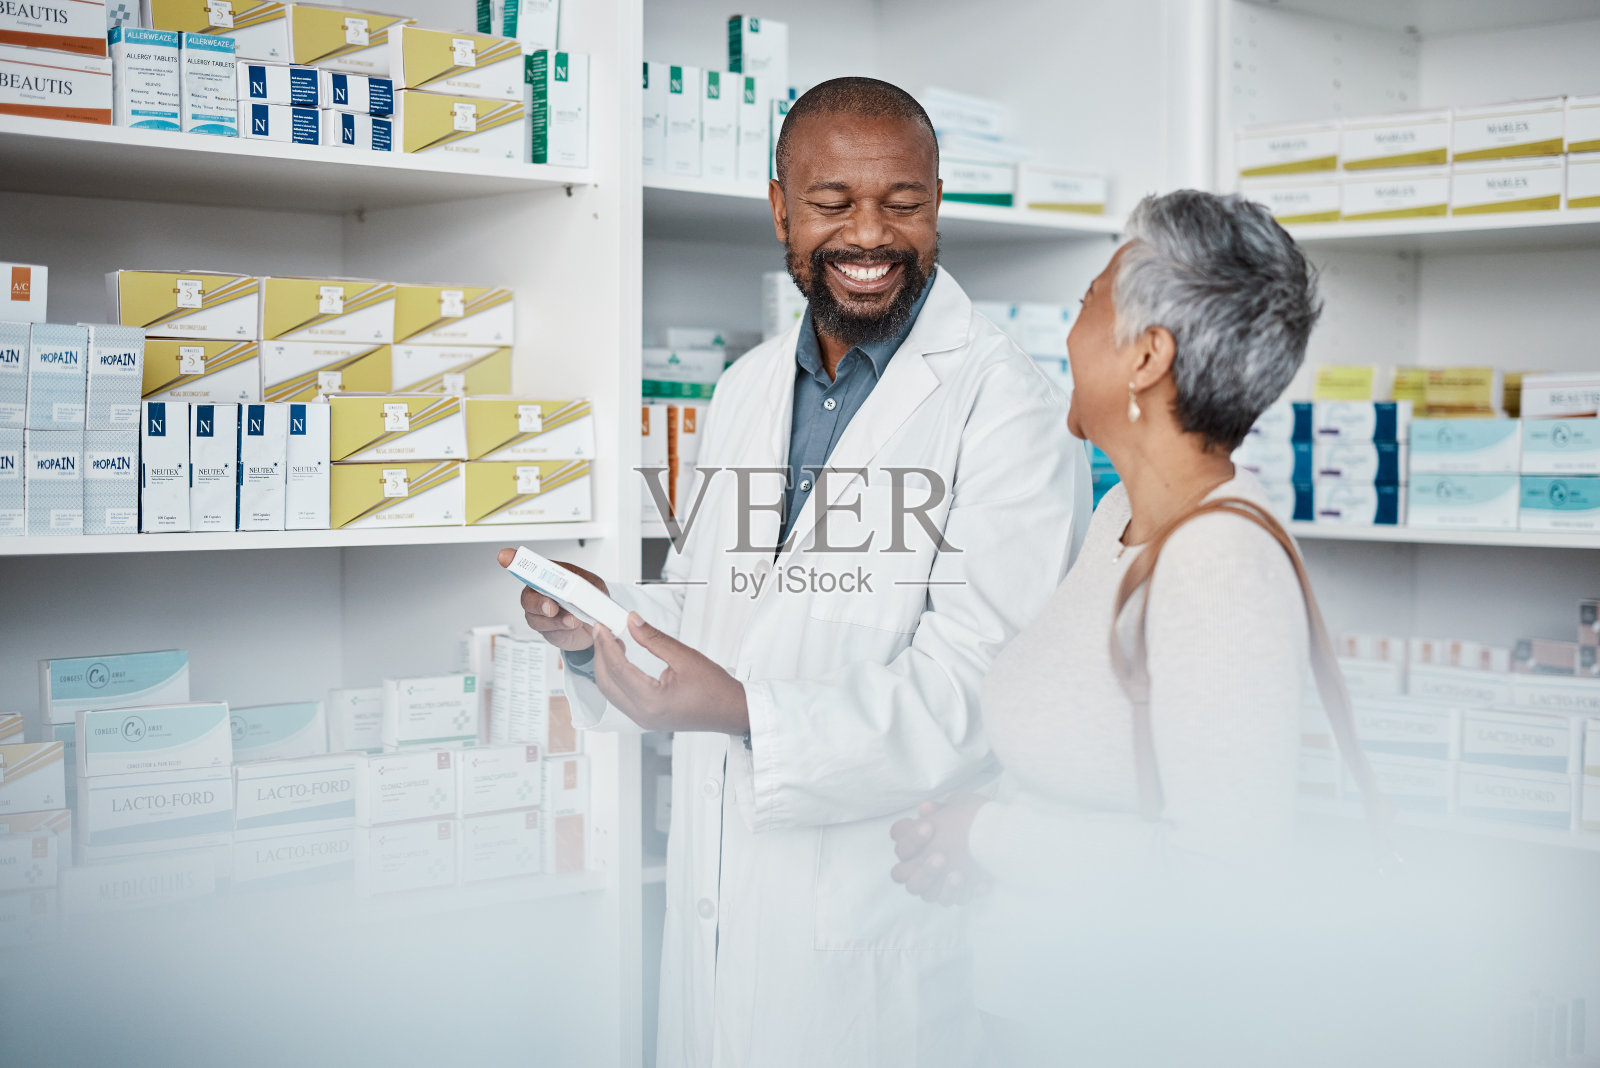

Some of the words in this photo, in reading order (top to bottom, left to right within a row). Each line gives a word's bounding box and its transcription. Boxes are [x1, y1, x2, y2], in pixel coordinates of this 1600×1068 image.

[127, 31, 172, 42] ALLERWEAZE
[188, 37, 230, 48] ALLERWEAZE
[126, 52, 152, 61] ALLERGY
[154, 55, 178, 64] TABLETS
[187, 58, 211, 67] ALLERGY
[212, 61, 235, 69] TABLETS
[556, 66, 567, 79] N
[0, 72, 73, 96] BEAUTIS
[252, 81, 264, 95] N
[335, 88, 346, 101] N
[254, 119, 266, 132] N
[344, 128, 353, 141] N
[13, 282, 29, 291] A/C
[40, 350, 78, 365] PROPAIN
[100, 352, 136, 367] PROPAIN
[151, 420, 163, 433] N
[199, 420, 211, 433] N
[250, 419, 262, 432] N
[292, 418, 304, 432] N
[37, 456, 75, 470] PROPAIN
[92, 456, 131, 470] PROPAIN
[151, 468, 179, 476] NEUTEX
[199, 468, 225, 476] NEUTEX
[59, 674, 83, 683] CONGEST
[111, 671, 126, 679] AWAY
[94, 727, 118, 736] CONGEST
[1477, 729, 1555, 748] LACTO-FORD
[257, 778, 351, 802] LACTO-FORD
[111, 790, 215, 813] LACTO-FORD
[255, 839, 350, 864] LACTO-FORD
